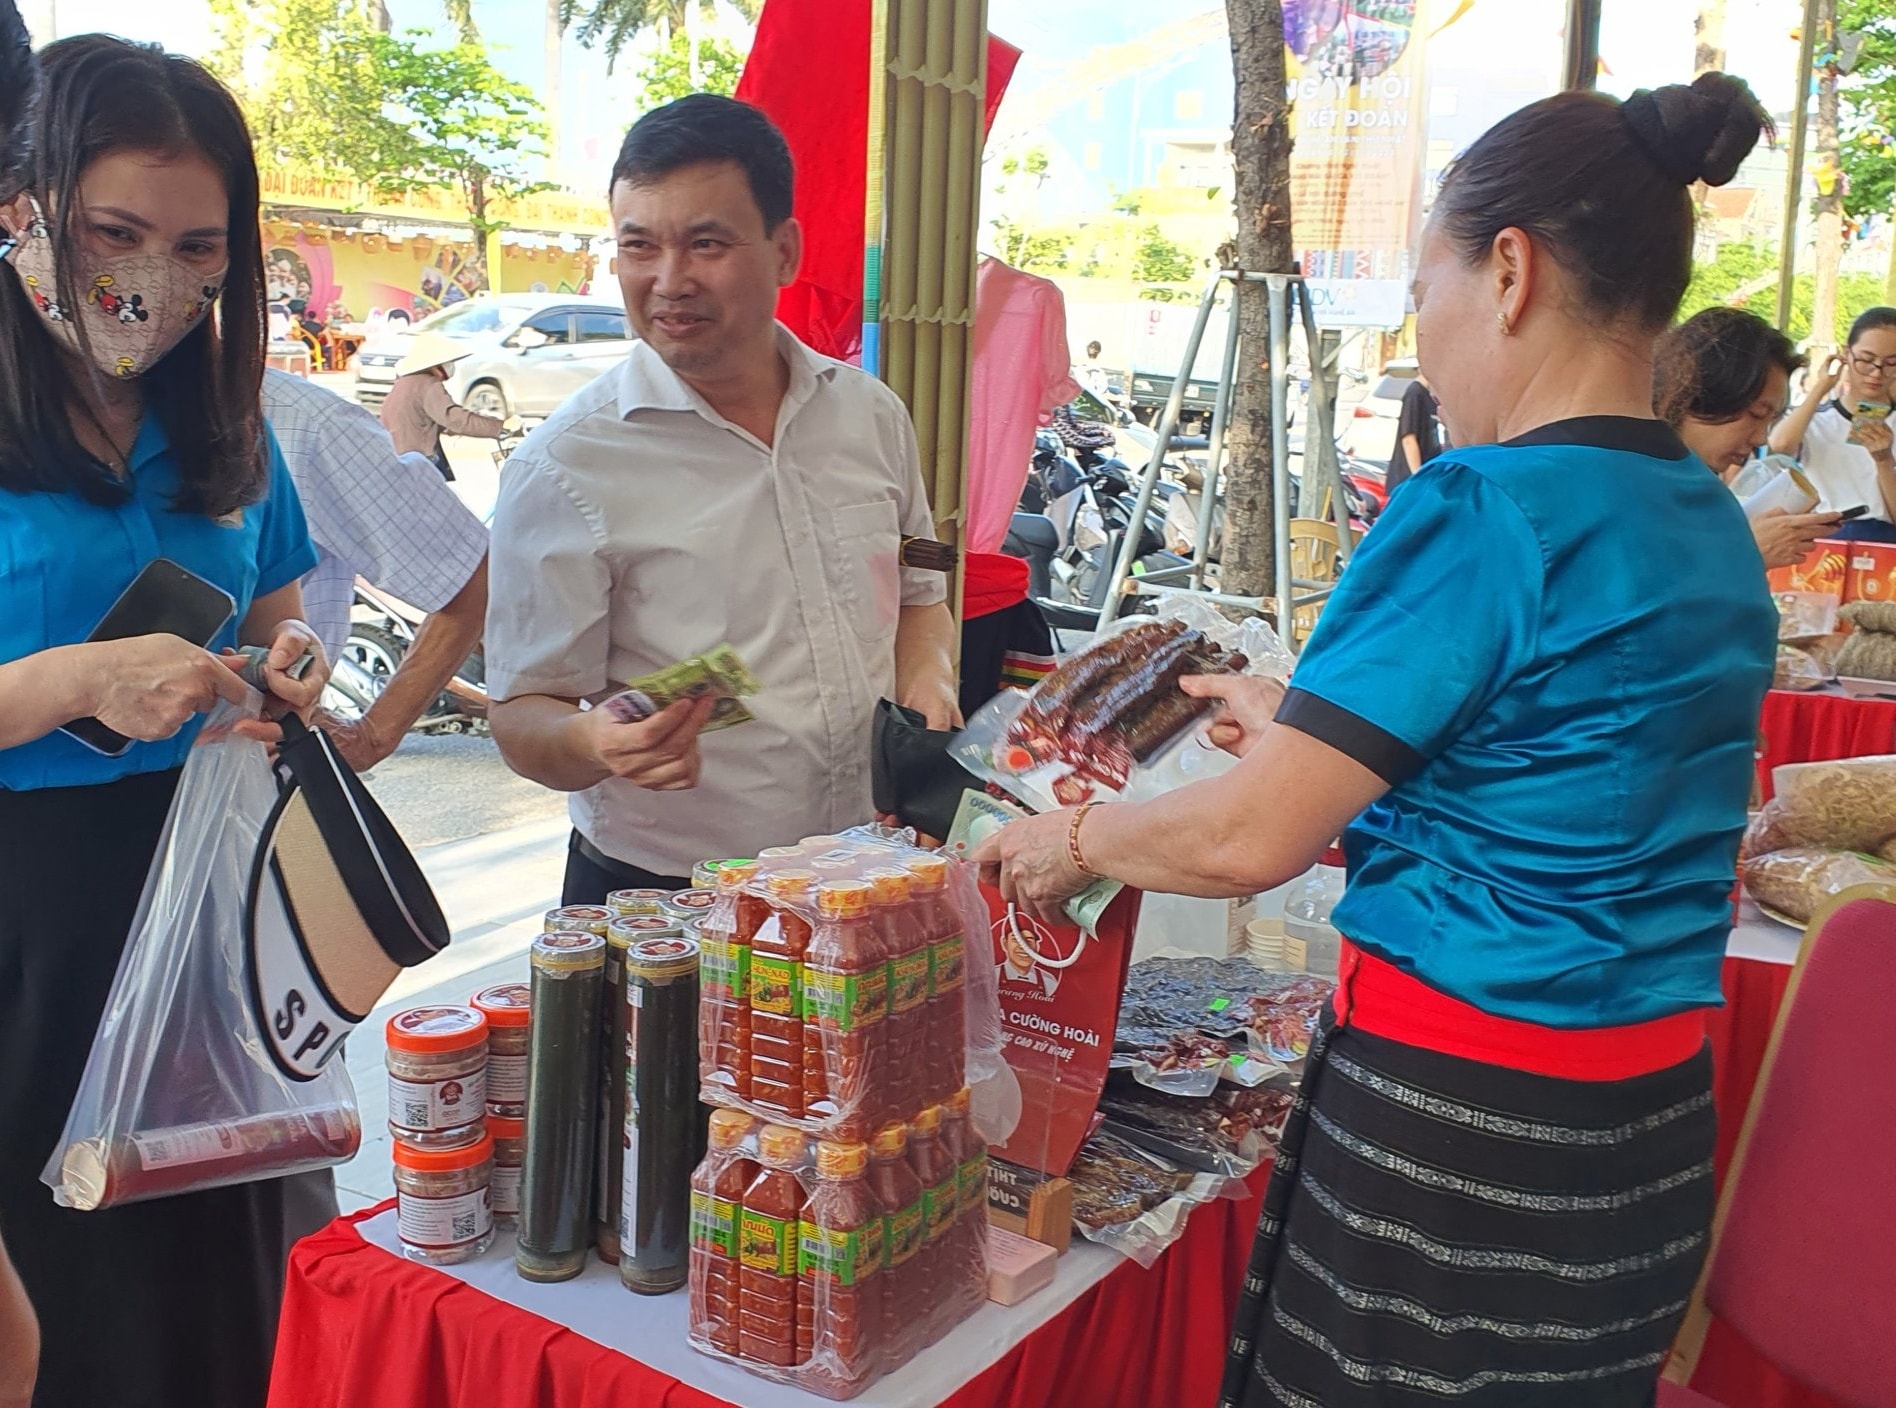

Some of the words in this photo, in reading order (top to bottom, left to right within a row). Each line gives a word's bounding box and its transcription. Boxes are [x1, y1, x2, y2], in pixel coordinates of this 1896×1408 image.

[1360, 70, 1410, 105] HỘI
[1306, 104, 1338, 128] KẾT
[1345, 104, 1408, 128] ĐOÀN
[1009, 1010, 1061, 1036] CƯỜNG
[1063, 1026, 1100, 1047] HOÀI
